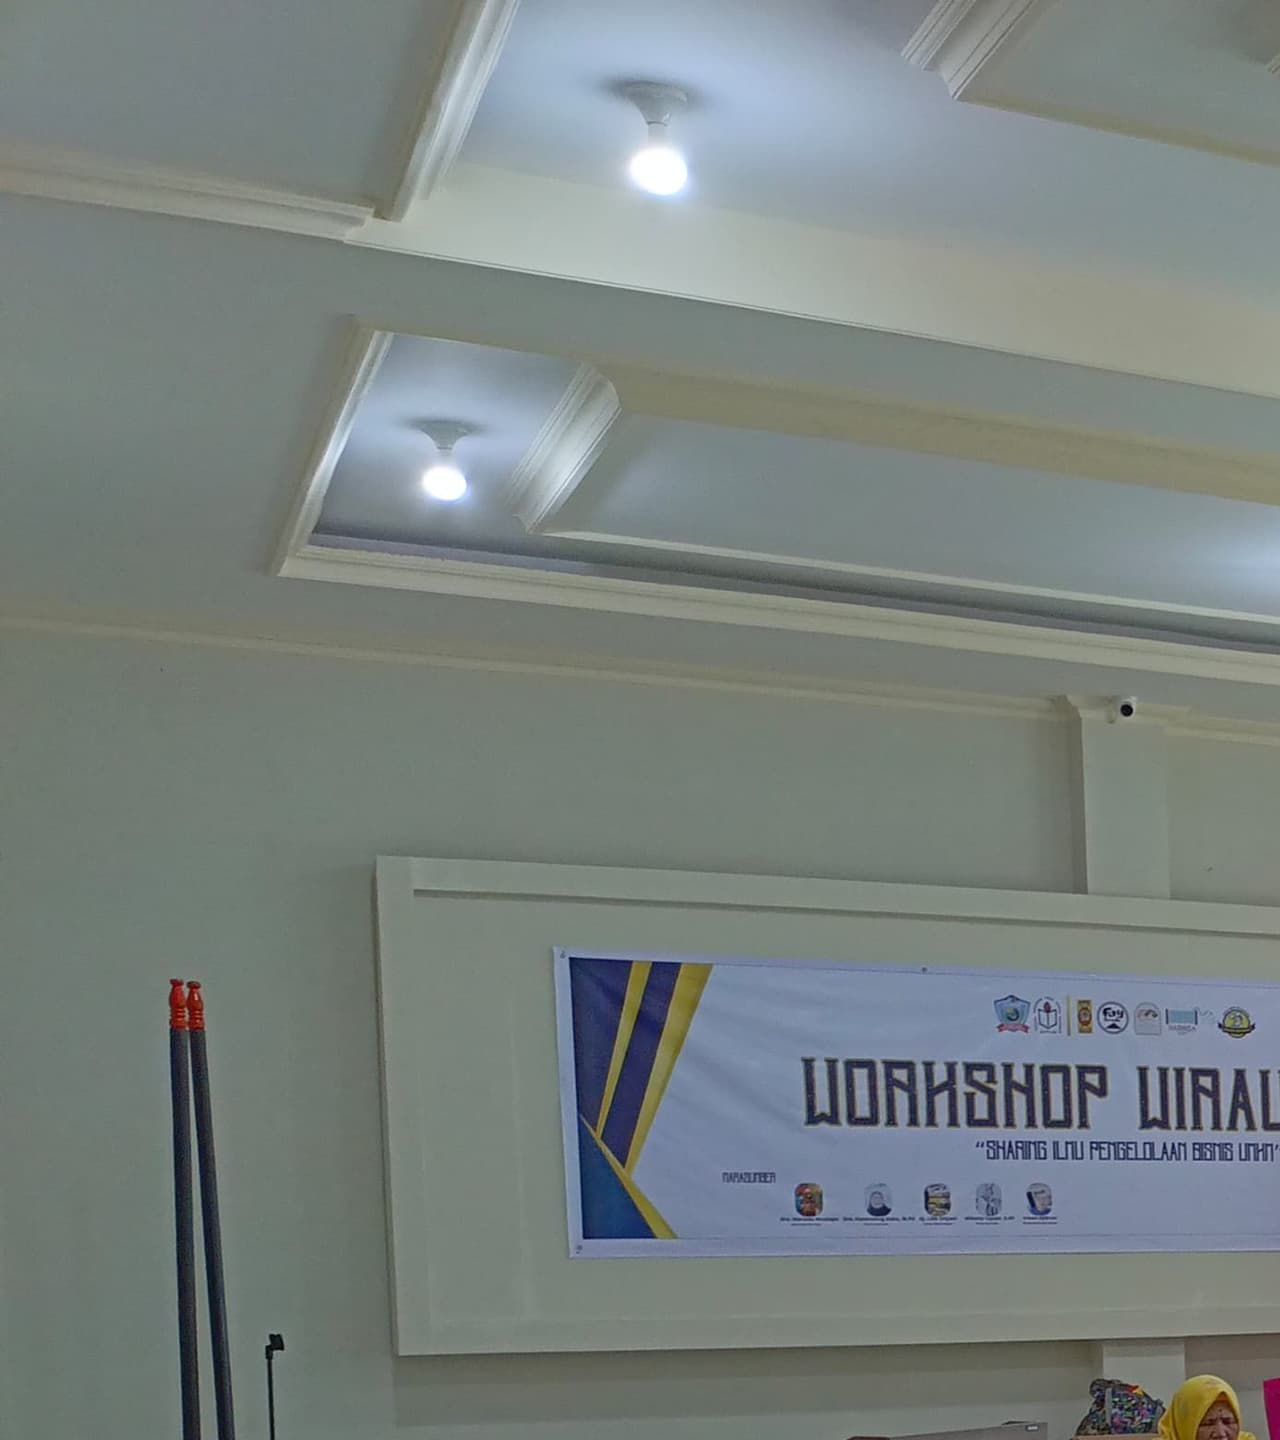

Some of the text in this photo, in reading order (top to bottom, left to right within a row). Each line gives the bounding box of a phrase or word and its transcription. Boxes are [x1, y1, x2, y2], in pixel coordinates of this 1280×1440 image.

[800, 1056, 1108, 1130] WORKSHOP
[1052, 1141, 1085, 1160] ILMU
[1089, 1141, 1188, 1161] PENGELOLAAN
[1192, 1142, 1234, 1161] BISNIS
